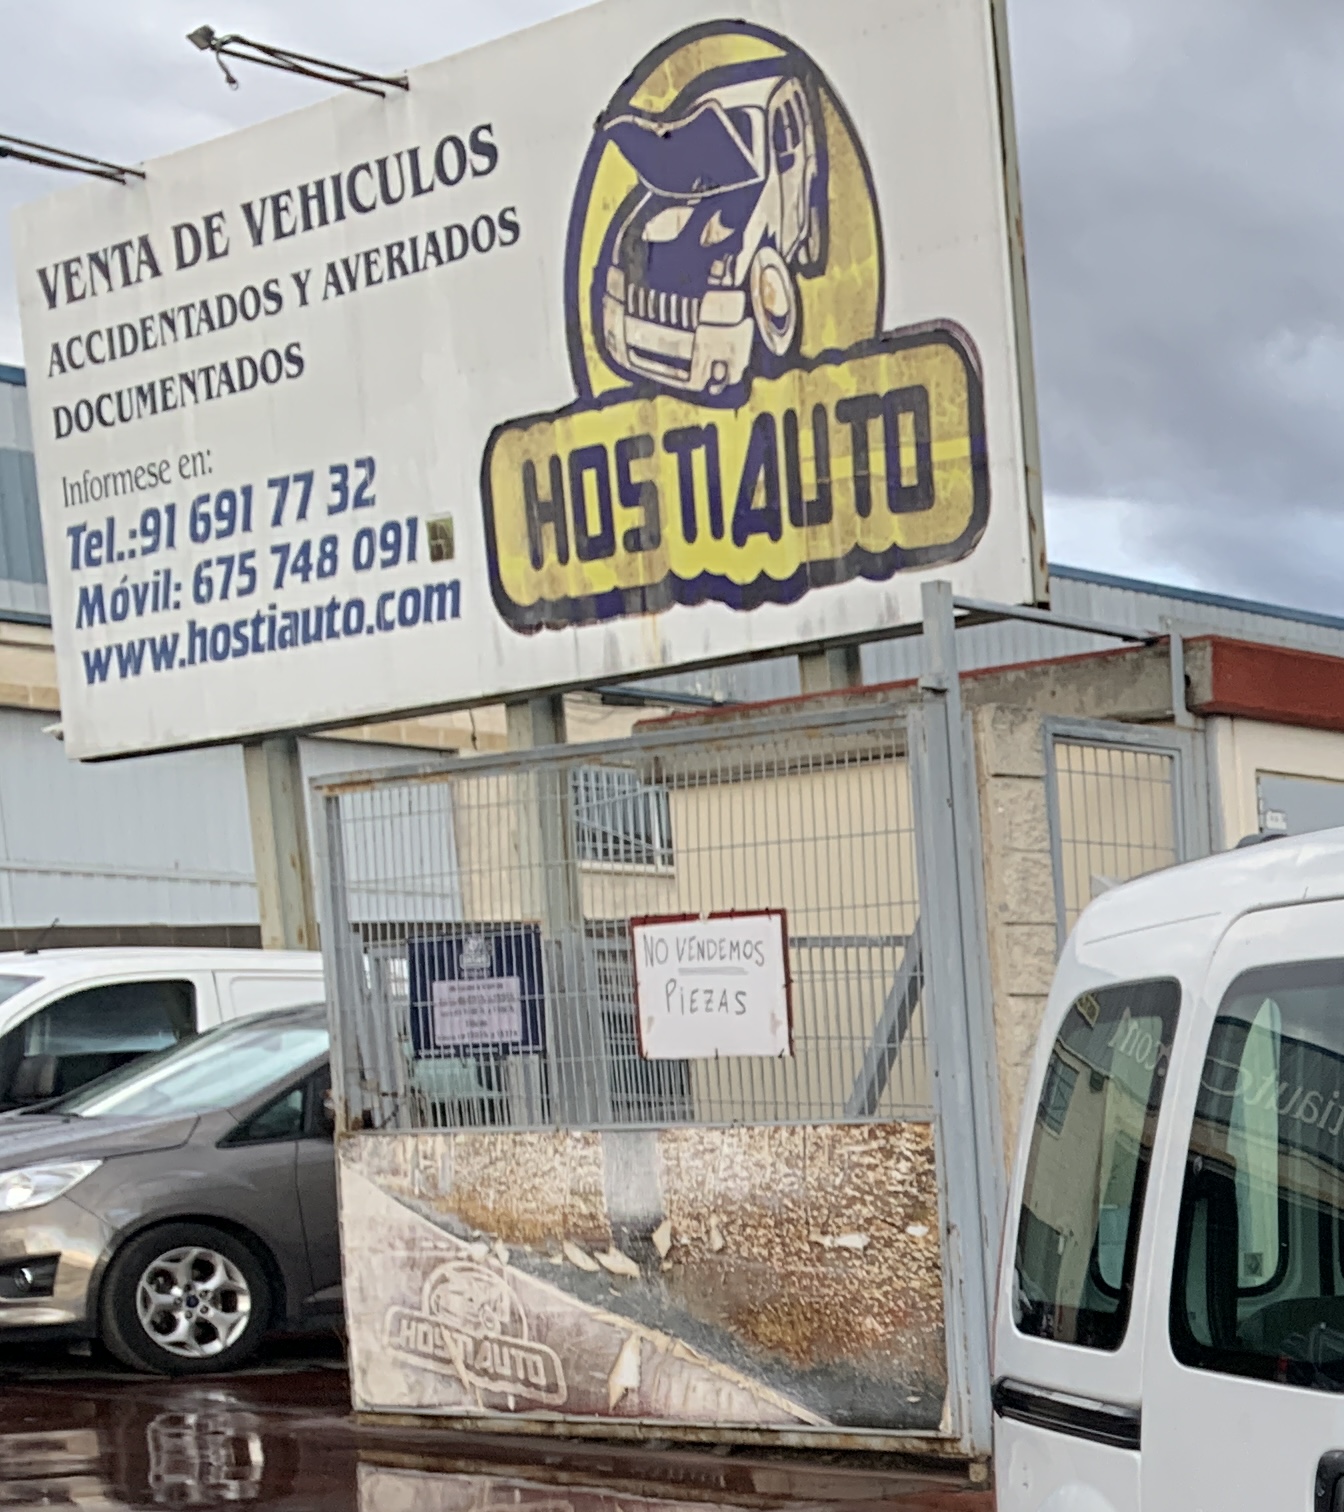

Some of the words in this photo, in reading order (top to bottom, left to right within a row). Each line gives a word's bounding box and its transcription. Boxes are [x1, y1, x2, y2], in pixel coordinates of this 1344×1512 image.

[37, 233, 162, 309] VENTA
[174, 212, 230, 271] DE
[241, 123, 500, 247] VEHICULOS
[47, 279, 283, 377] ACCIDENTADOS
[291, 271, 311, 305] Y
[322, 206, 521, 300] AVERIADOS
[53, 342, 305, 438] DOCUMENTADOS
[61, 456, 172, 507] Informese
[178, 447, 213, 481] en:
[189, 484, 253, 541] 691
[268, 472, 315, 527] 77
[328, 456, 376, 514] 32
[523, 384, 935, 570] HOSTIAUTO
[75, 574, 182, 629] Móvil:
[192, 550, 257, 605] 675
[270, 538, 338, 588] 748
[353, 516, 419, 570] 091
[82, 577, 461, 685] www.hostiauto.com
[643, 934, 669, 967] NO
[676, 935, 765, 967] VENDEMOS
